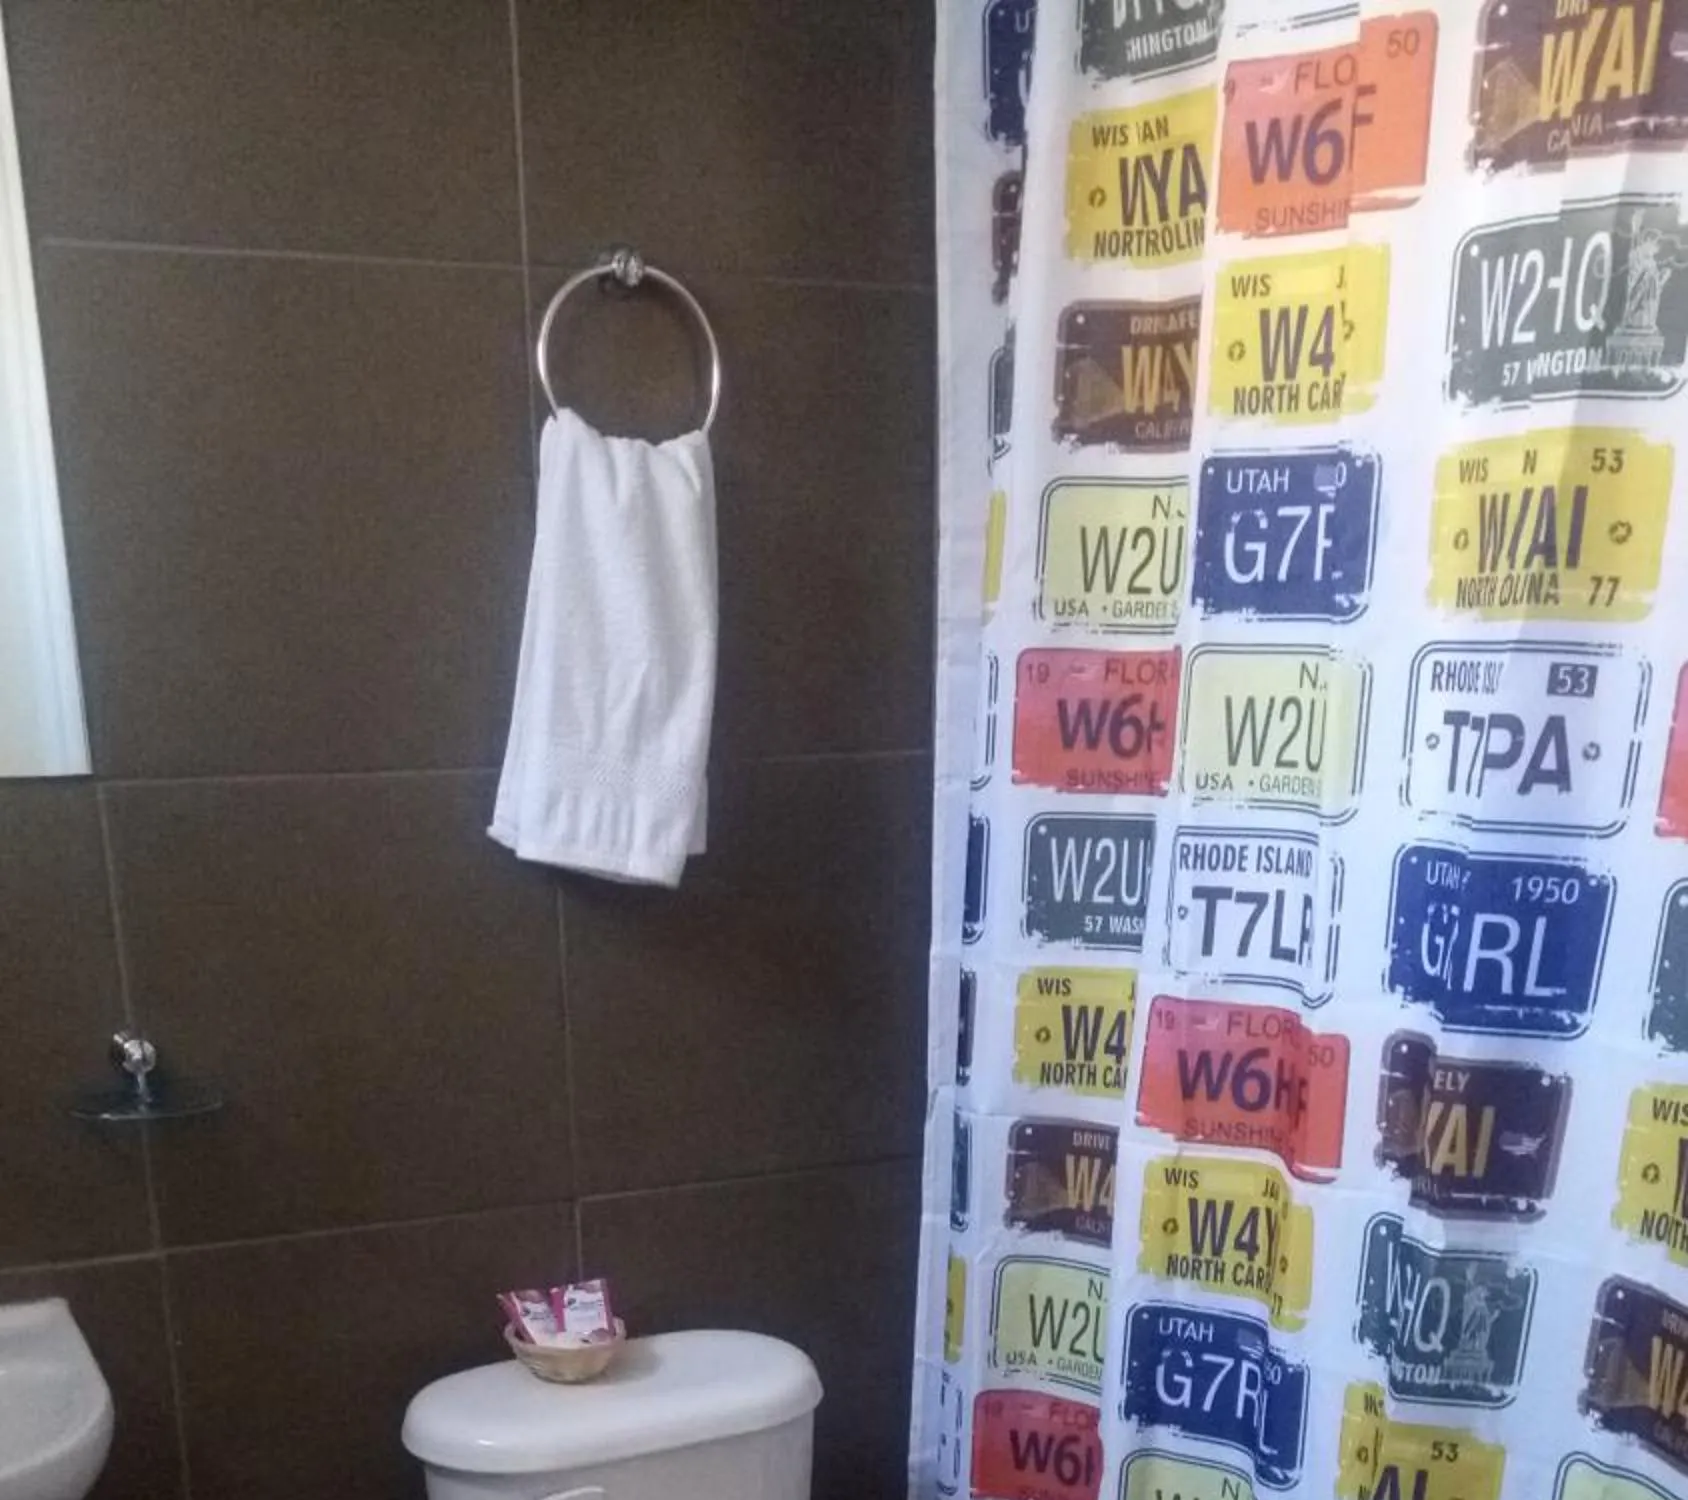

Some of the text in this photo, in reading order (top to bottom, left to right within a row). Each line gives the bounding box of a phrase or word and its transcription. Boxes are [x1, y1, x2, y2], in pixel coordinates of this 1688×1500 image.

[1091, 124, 1129, 148] WIS
[1231, 273, 1272, 299] WIS
[1259, 303, 1335, 382] W4
[1233, 382, 1300, 416] NORTH
[1459, 457, 1489, 484] WIS
[1591, 447, 1625, 474] 53
[1226, 467, 1290, 494] UTAH
[1080, 524, 1185, 595] W2U
[1588, 576, 1621, 608] 77
[1053, 599, 1089, 617] USA
[1556, 666, 1591, 695] 53
[1225, 694, 1327, 773] W2U
[1195, 772, 1234, 792] USA
[1179, 842, 1249, 873] RHODE
[1511, 874, 1581, 905] 1950
[1083, 915, 1104, 934] 57
[1036, 977, 1072, 997] WIS
[1061, 1003, 1127, 1066] W4
[1040, 1060, 1098, 1087] NORTH
[1164, 1167, 1201, 1190] WIS
[1167, 1253, 1226, 1283] NORTH
[1158, 1317, 1215, 1344] UTAH
[1430, 1440, 1460, 1463] 53
